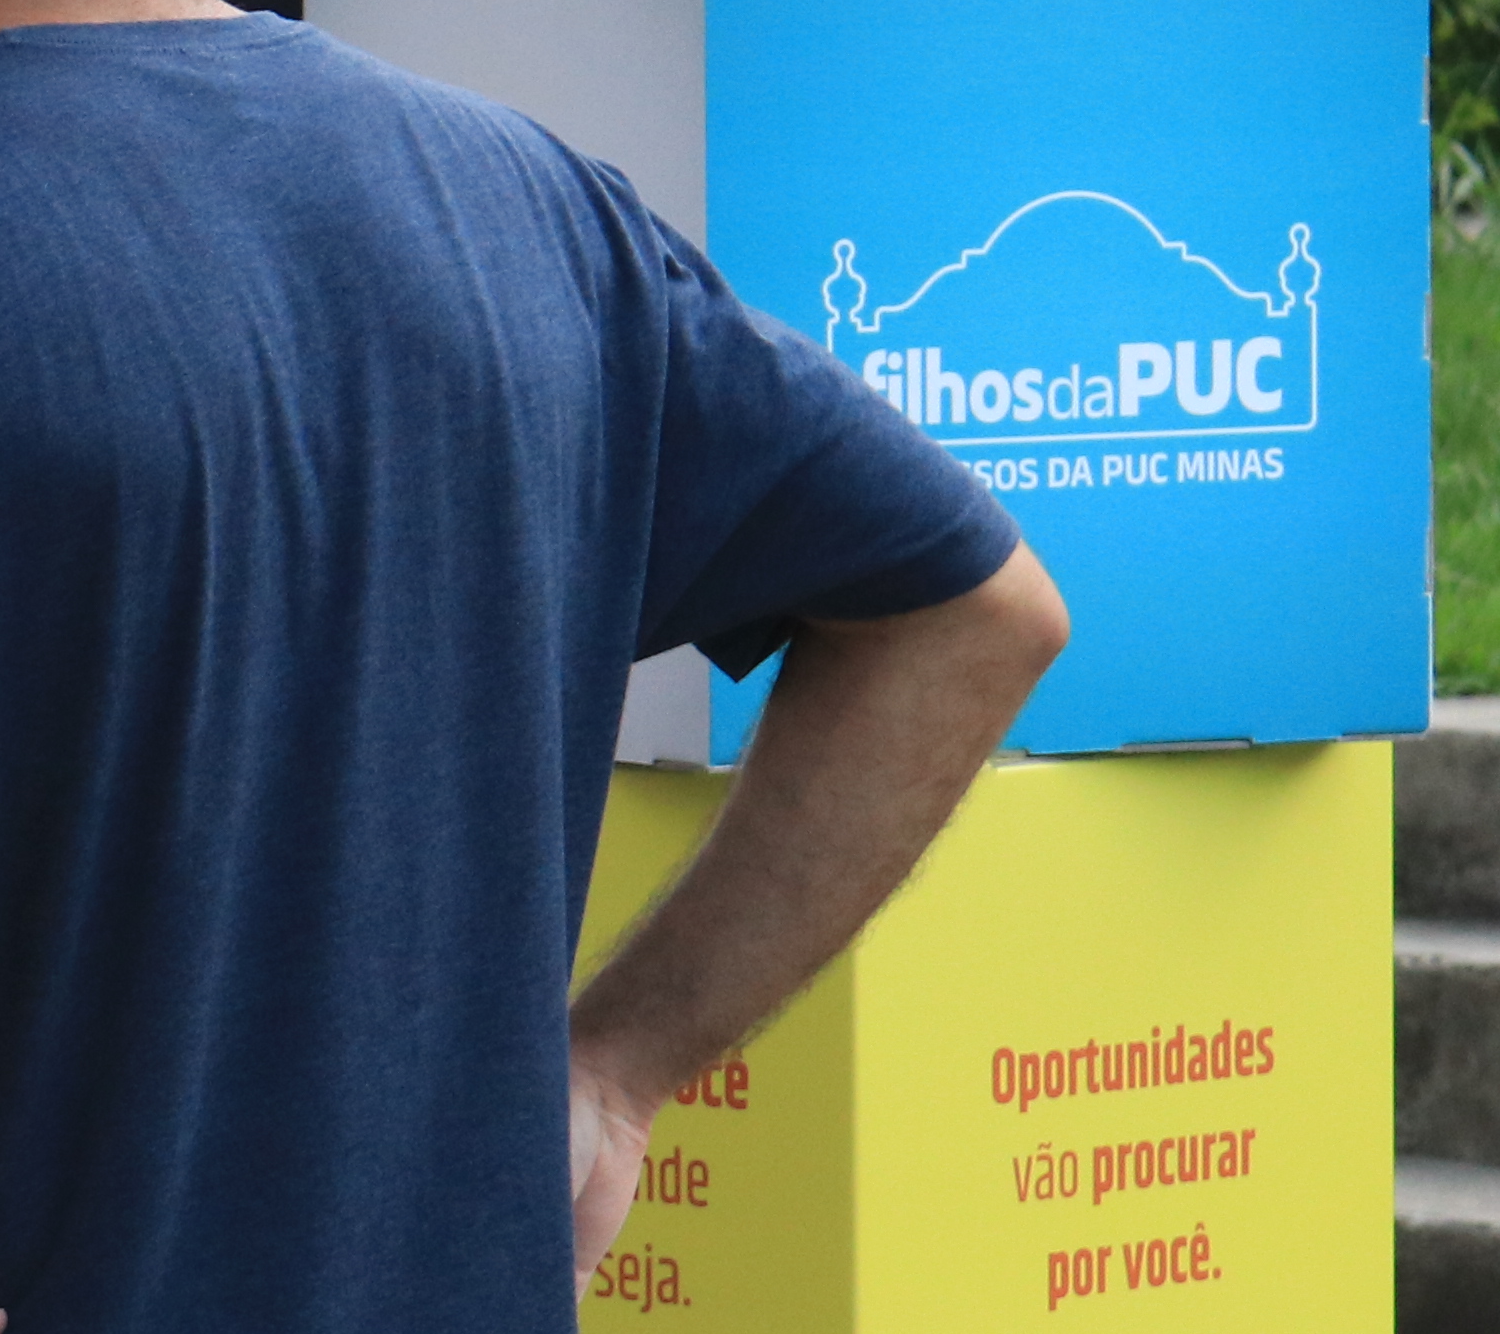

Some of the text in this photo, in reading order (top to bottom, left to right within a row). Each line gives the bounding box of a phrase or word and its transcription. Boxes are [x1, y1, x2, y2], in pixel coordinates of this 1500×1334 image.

[961, 447, 1285, 492] SOS DA PUC MINAS
[991, 1018, 1275, 1114] Oportunidades
[1013, 1127, 1257, 1206] vão procurar
[594, 1242, 692, 1314] seja.
[1046, 1222, 1223, 1312] por você.
